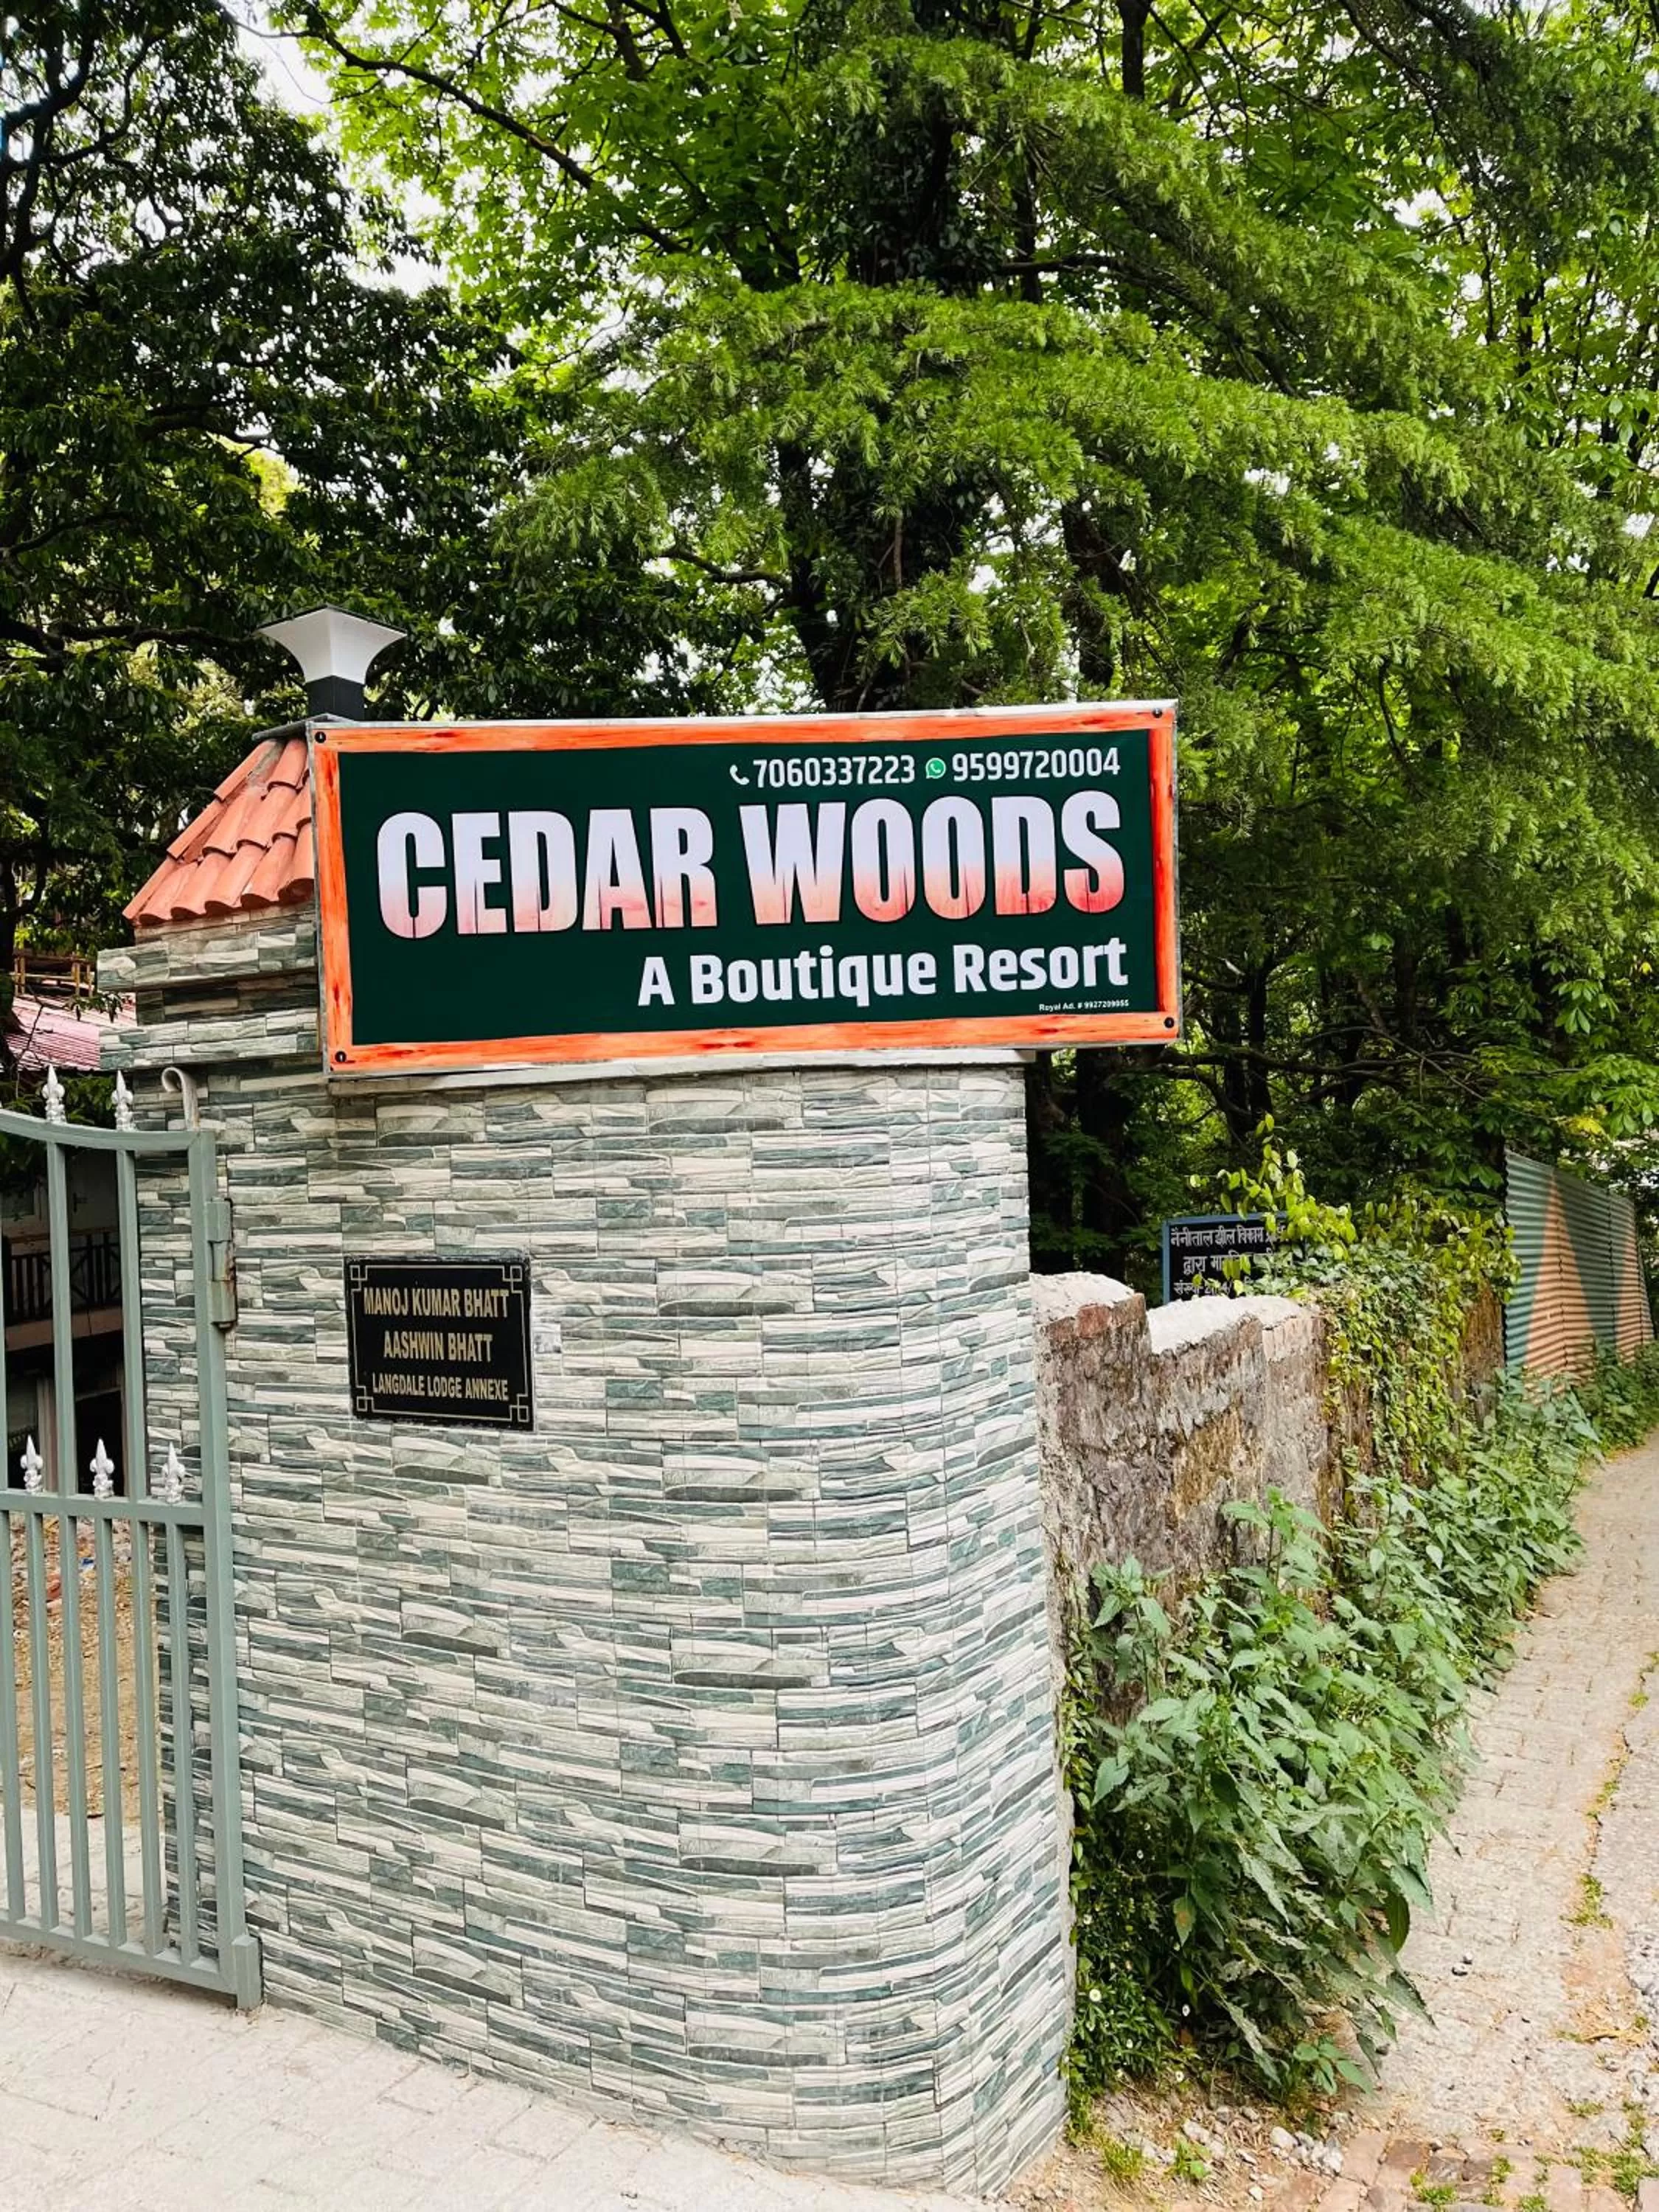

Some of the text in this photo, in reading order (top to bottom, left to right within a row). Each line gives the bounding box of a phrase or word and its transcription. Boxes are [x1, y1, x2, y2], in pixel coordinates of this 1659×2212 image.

[753, 747, 1121, 788] 7060337223 9599720004
[376, 789, 1125, 939] CEDAR WOODS
[638, 937, 1129, 1007] A Boutique Resort
[1039, 1003, 1061, 1012] Royal
[1170, 1226, 1214, 1247] नैनीताल
[1236, 1225, 1265, 1245] विकास
[364, 1287, 509, 1318] MANOJ KUMAR BHATT
[383, 1330, 493, 1363] AASHWIN BHATT
[372, 1372, 509, 1401] LANGDALE LODGE ANNEXE
